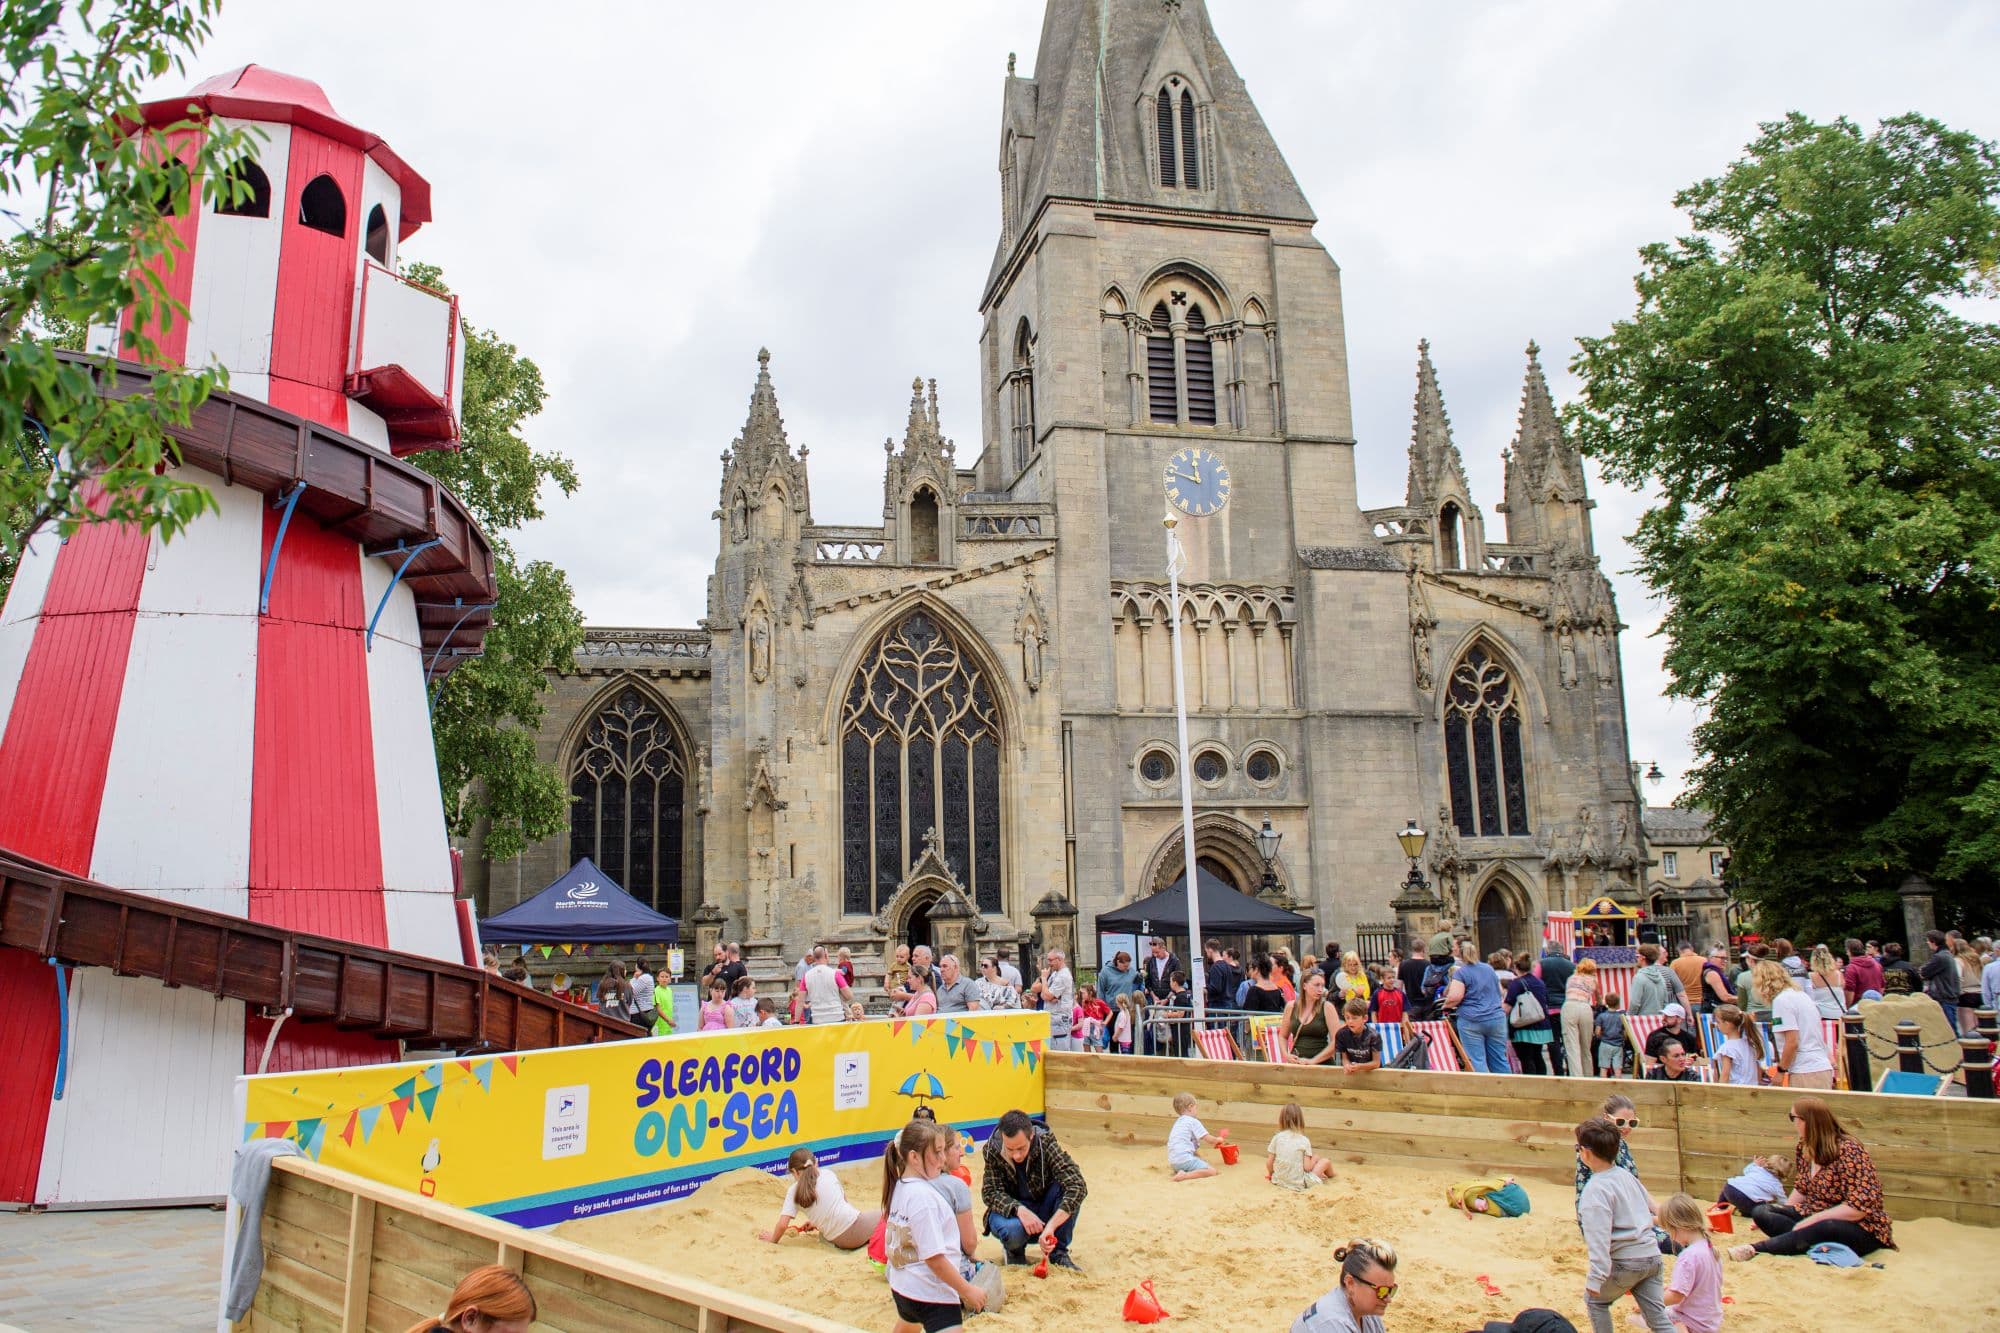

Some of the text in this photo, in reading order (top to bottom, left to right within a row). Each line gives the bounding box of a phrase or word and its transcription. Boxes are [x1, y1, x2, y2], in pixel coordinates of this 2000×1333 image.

[636, 1047, 801, 1108] SLEAFORD
[563, 1124, 575, 1132] area
[634, 1089, 799, 1158] ON-SEA
[551, 1132, 579, 1143] covered by
[557, 1143, 572, 1151] CCTV
[573, 1203, 593, 1215] Enjoy
[592, 1198, 611, 1210] sand,
[611, 1197, 623, 1206] sun
[623, 1195, 636, 1204] and
[636, 1189, 661, 1201] buckets
[662, 1184, 670, 1196] of
[670, 1184, 681, 1194] fun
[681, 1183, 689, 1191] as
[688, 1180, 700, 1190] the
